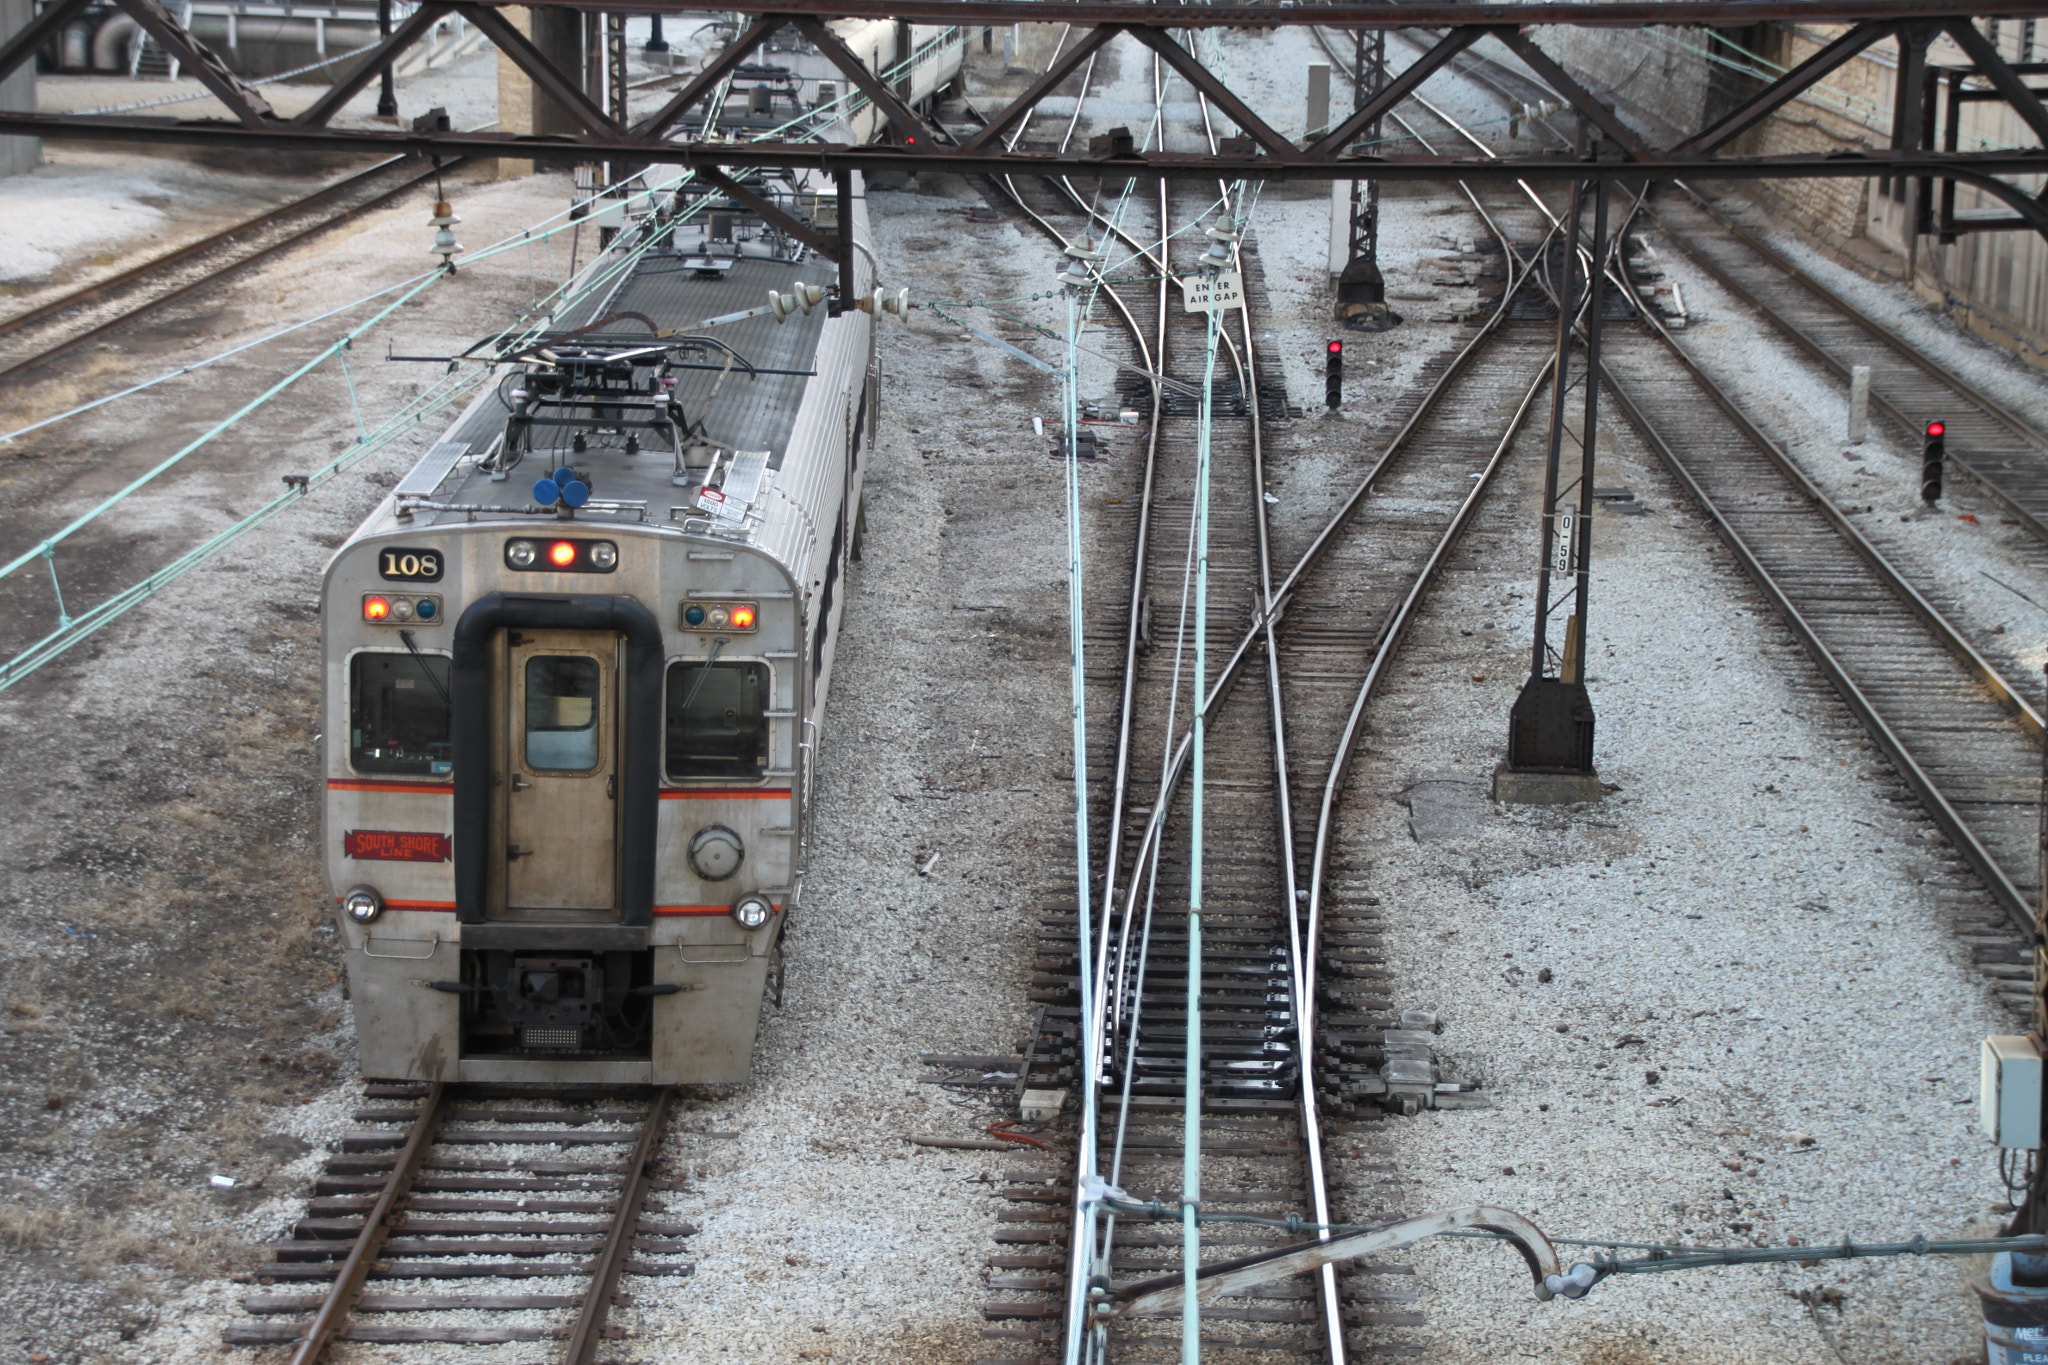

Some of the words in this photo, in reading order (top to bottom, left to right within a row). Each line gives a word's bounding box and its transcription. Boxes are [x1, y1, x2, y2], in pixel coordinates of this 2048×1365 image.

[1195, 282, 1229, 292] ENER
[1190, 296, 1209, 304] AIR
[1214, 292, 1238, 302] GAP
[384, 553, 438, 576] 108
[356, 834, 395, 854] SOUTH
[400, 836, 441, 857] SHORE
[380, 848, 413, 857] LINE
